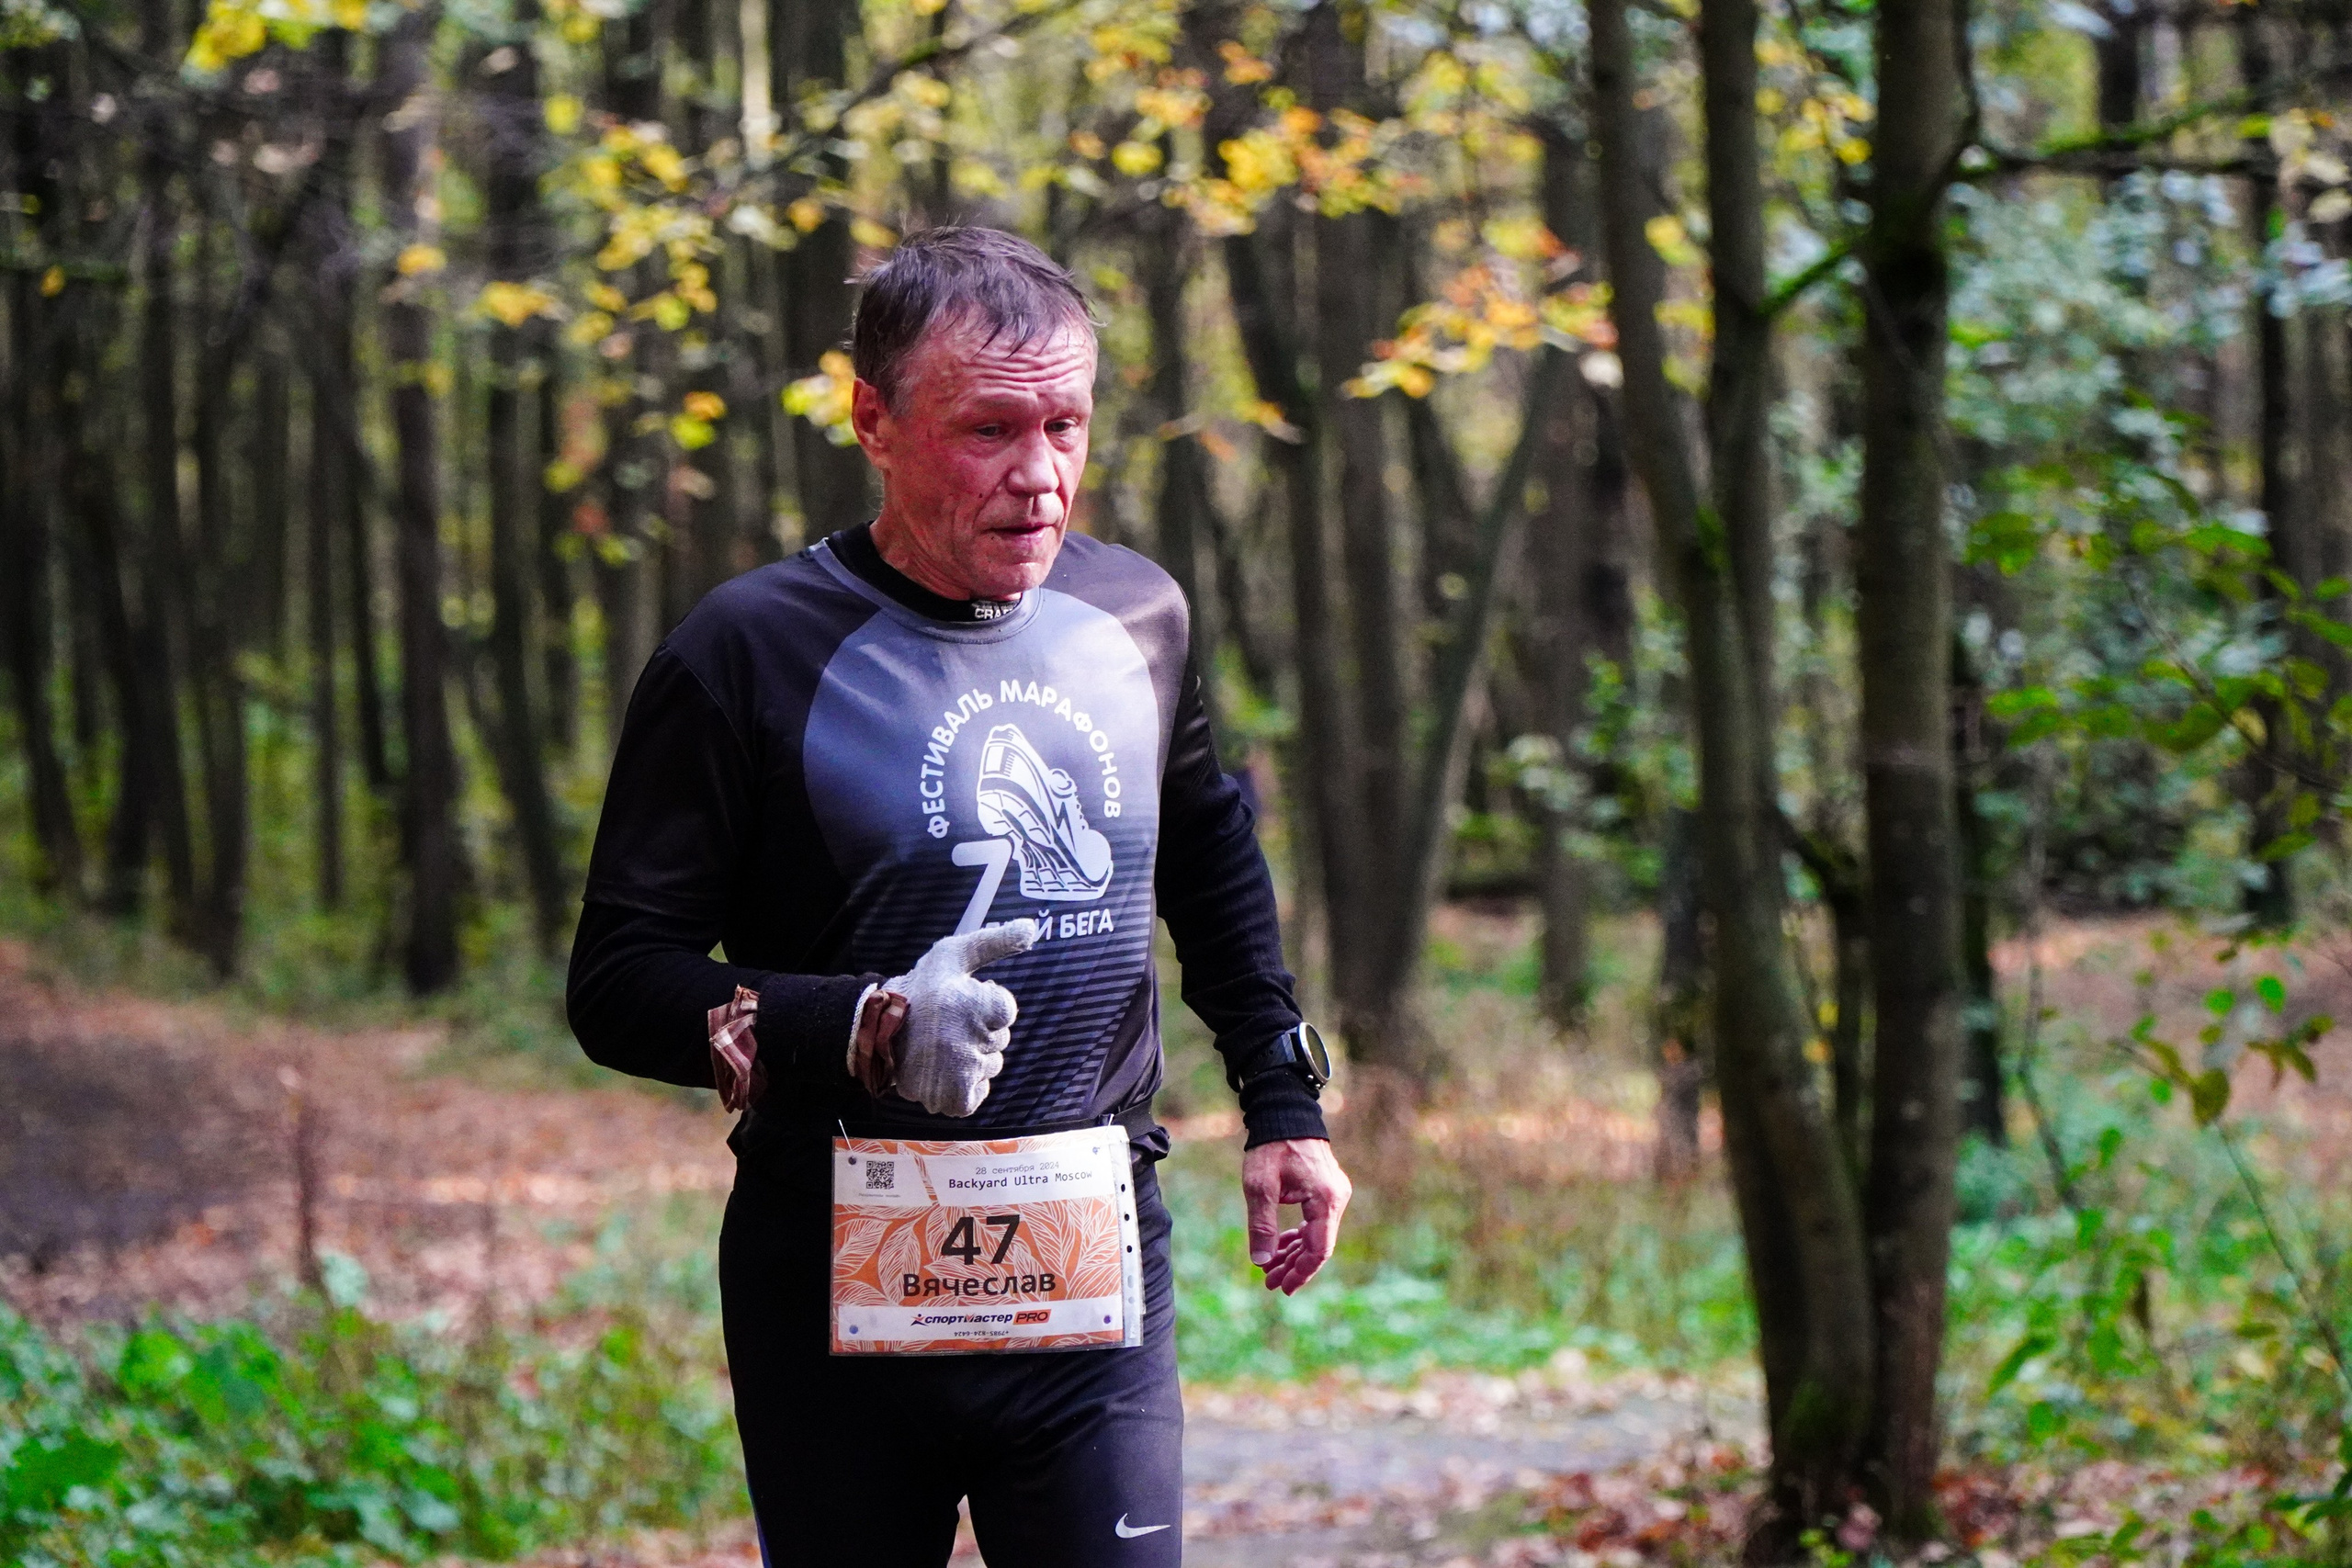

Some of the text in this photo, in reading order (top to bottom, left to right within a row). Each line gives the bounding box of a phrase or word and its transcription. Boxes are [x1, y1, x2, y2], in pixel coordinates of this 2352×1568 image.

[920, 679, 1121, 839] ФЕСТИВАЛЬ МАРАФОНОВ
[1059, 908, 1114, 939] БЕГА
[948, 1170, 1092, 1191] Backyard Ultra Moscow
[975, 1161, 1059, 1175] 28 сентября 2024
[940, 1213, 1021, 1266] 47
[902, 1272, 1057, 1297] Вячеслав
[1015, 1311, 1049, 1324] PRO
